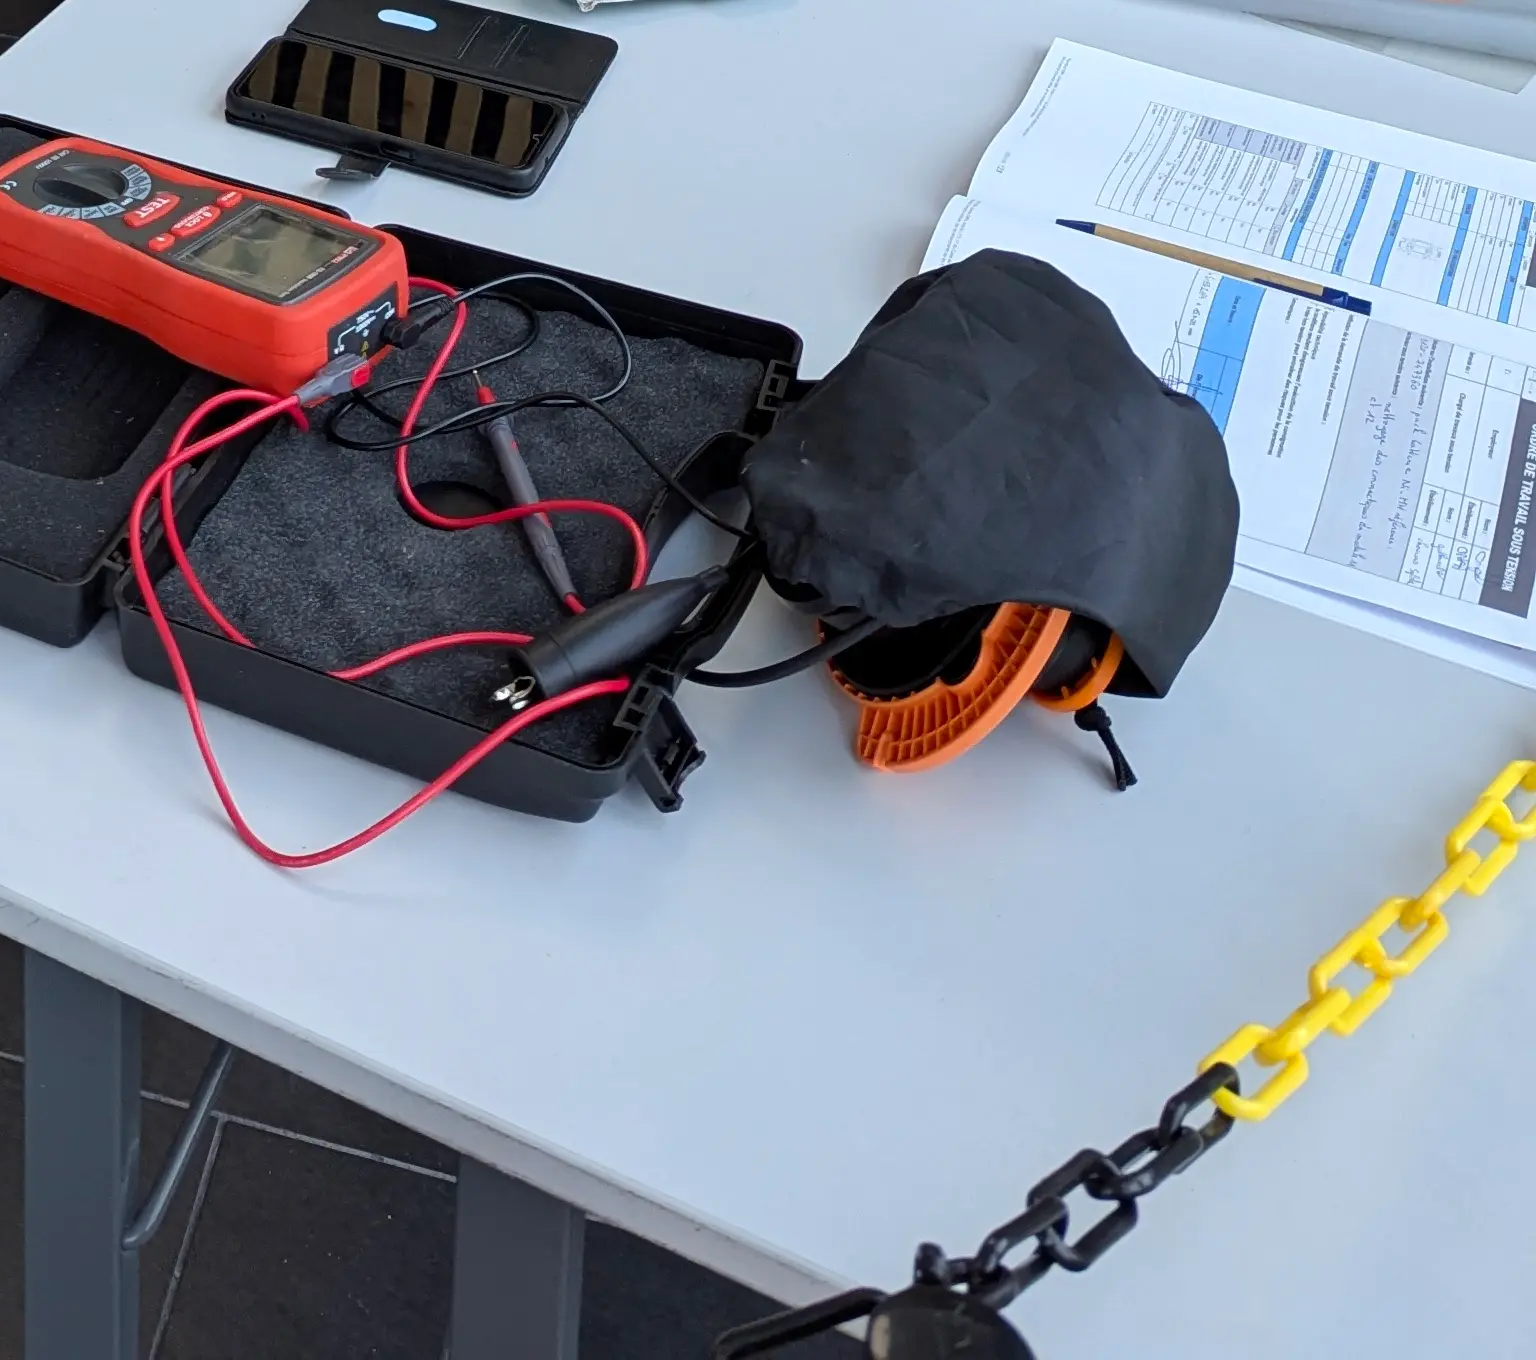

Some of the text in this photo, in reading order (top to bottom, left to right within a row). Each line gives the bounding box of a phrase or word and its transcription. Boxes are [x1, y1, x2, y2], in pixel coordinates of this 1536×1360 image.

[136, 197, 170, 218] TEST
[1292, 342, 1300, 355] peut
[1329, 371, 1338, 388] travail
[1278, 388, 1289, 408] risques
[1455, 391, 1466, 410] Chargé
[1275, 408, 1284, 421] pour
[1321, 401, 1331, 421] tension
[1364, 409, 1376, 425] 12
[1265, 428, 1278, 456] personnes
[1447, 439, 1455, 452] sous
[1443, 452, 1453, 473] tension
[1522, 460, 1536, 478] DE
[1511, 478, 1535, 526] TRAVAIL
[1507, 526, 1524, 555] SOUS
[1499, 554, 1520, 592] TENSION
